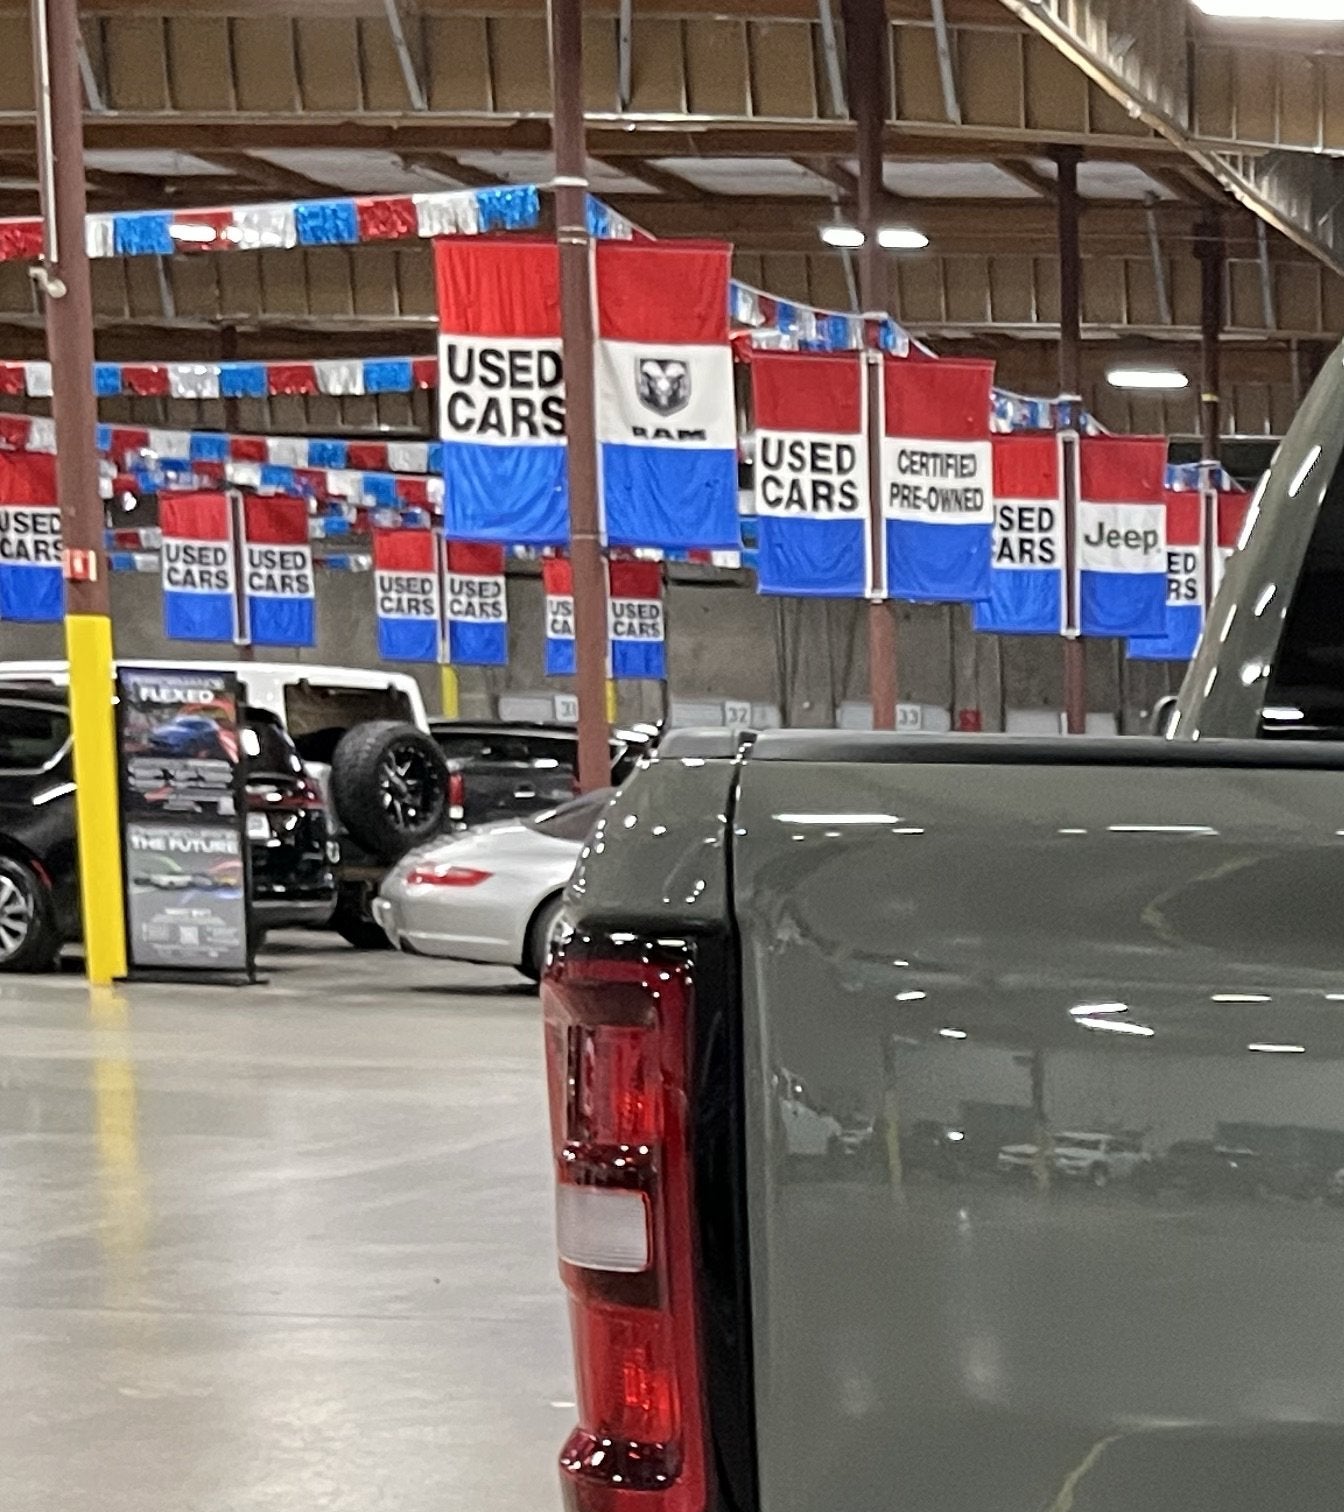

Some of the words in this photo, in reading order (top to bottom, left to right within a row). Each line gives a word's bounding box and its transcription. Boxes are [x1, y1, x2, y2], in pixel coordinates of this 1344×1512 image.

[447, 344, 563, 390] USED
[447, 391, 566, 438] CARS
[631, 425, 707, 441] RAM
[761, 437, 857, 475] USED
[897, 448, 978, 479] CERTIFIED
[761, 475, 859, 513] CARS
[889, 482, 984, 513] PRE-OWNED
[0, 511, 61, 534] USED
[1084, 521, 1159, 554] Jeep
[0, 538, 63, 561] CARS
[165, 544, 227, 566] USED
[249, 548, 307, 570] USED
[994, 537, 1055, 564] ARS
[1167, 551, 1197, 574] ED
[167, 566, 229, 589] CARS
[249, 572, 310, 593] CARS
[380, 576, 433, 595] USED
[450, 578, 501, 599] USED
[1167, 578, 1198, 601] RS
[380, 596, 434, 615] CARS
[449, 599, 503, 619] CARS
[550, 600, 572, 617] US
[612, 602, 660, 619] USED
[551, 619, 572, 634] CA
[613, 621, 661, 638] CARS
